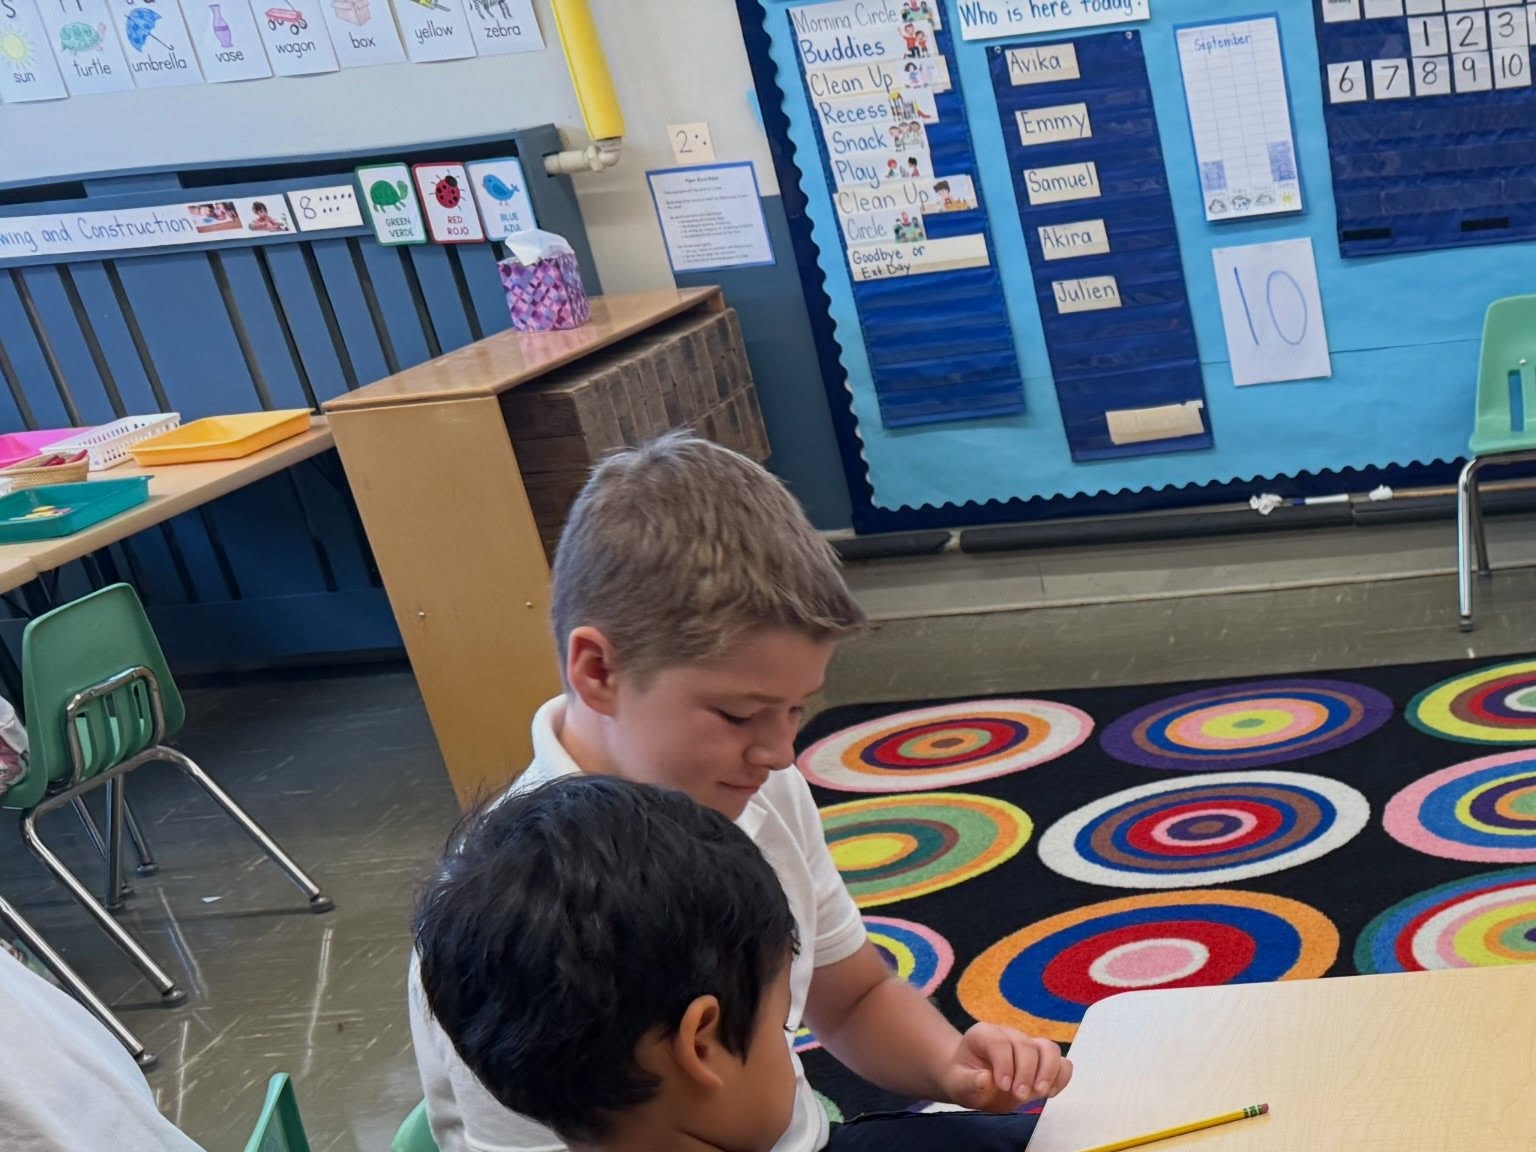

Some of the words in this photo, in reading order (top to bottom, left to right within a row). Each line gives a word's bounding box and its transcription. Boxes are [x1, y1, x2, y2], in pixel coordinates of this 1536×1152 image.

[855, 2, 899, 26] Circle
[959, 4, 999, 27] Who
[1007, 1, 1023, 23] is
[1030, 0, 1073, 18] here
[349, 31, 376, 49] box
[415, 20, 454, 45] yellow
[484, 21, 522, 38] zebra
[1422, 20, 1429, 47] 1
[1456, 16, 1478, 47] 2
[1498, 11, 1515, 37] 3
[275, 39, 316, 59] wagon
[799, 35, 885, 64] Buddies
[1194, 33, 1252, 54] September
[132, 52, 187, 72] umbrella
[215, 49, 245, 63] vase
[1010, 50, 1062, 73] Avika
[13, 71, 35, 83] sun
[73, 58, 112, 78] turtle
[1338, 65, 1354, 93] 6
[1381, 65, 1399, 90] 7
[1422, 61, 1438, 84] 8
[1462, 56, 1476, 82] 9
[1501, 53, 1523, 79] 10
[810, 72, 863, 97] Clean
[867, 64, 893, 95] Up
[819, 101, 888, 125] Recess
[1021, 112, 1085, 137] Emmy
[676, 130, 693, 153] 2
[832, 126, 888, 153] Snack
[835, 160, 880, 188] Play
[1028, 164, 1094, 193] Samuel
[300, 196, 316, 219] 8
[838, 191, 896, 214] Clean
[903, 183, 929, 211] Up
[42, 220, 72, 243] and
[77, 211, 196, 241] Construction
[385, 217, 411, 227] GREEN
[447, 215, 463, 224] RED
[500, 212, 518, 222] BLUE
[847, 216, 887, 241] Circle
[389, 228, 414, 238] VERDE
[447, 227, 469, 236] ROJO
[1043, 227, 1092, 249] Akira
[852, 248, 904, 266] Goodbye
[912, 245, 926, 257] or
[886, 262, 911, 275] Day
[1056, 281, 1115, 303] Julien
[1233, 266, 1308, 347] 10
